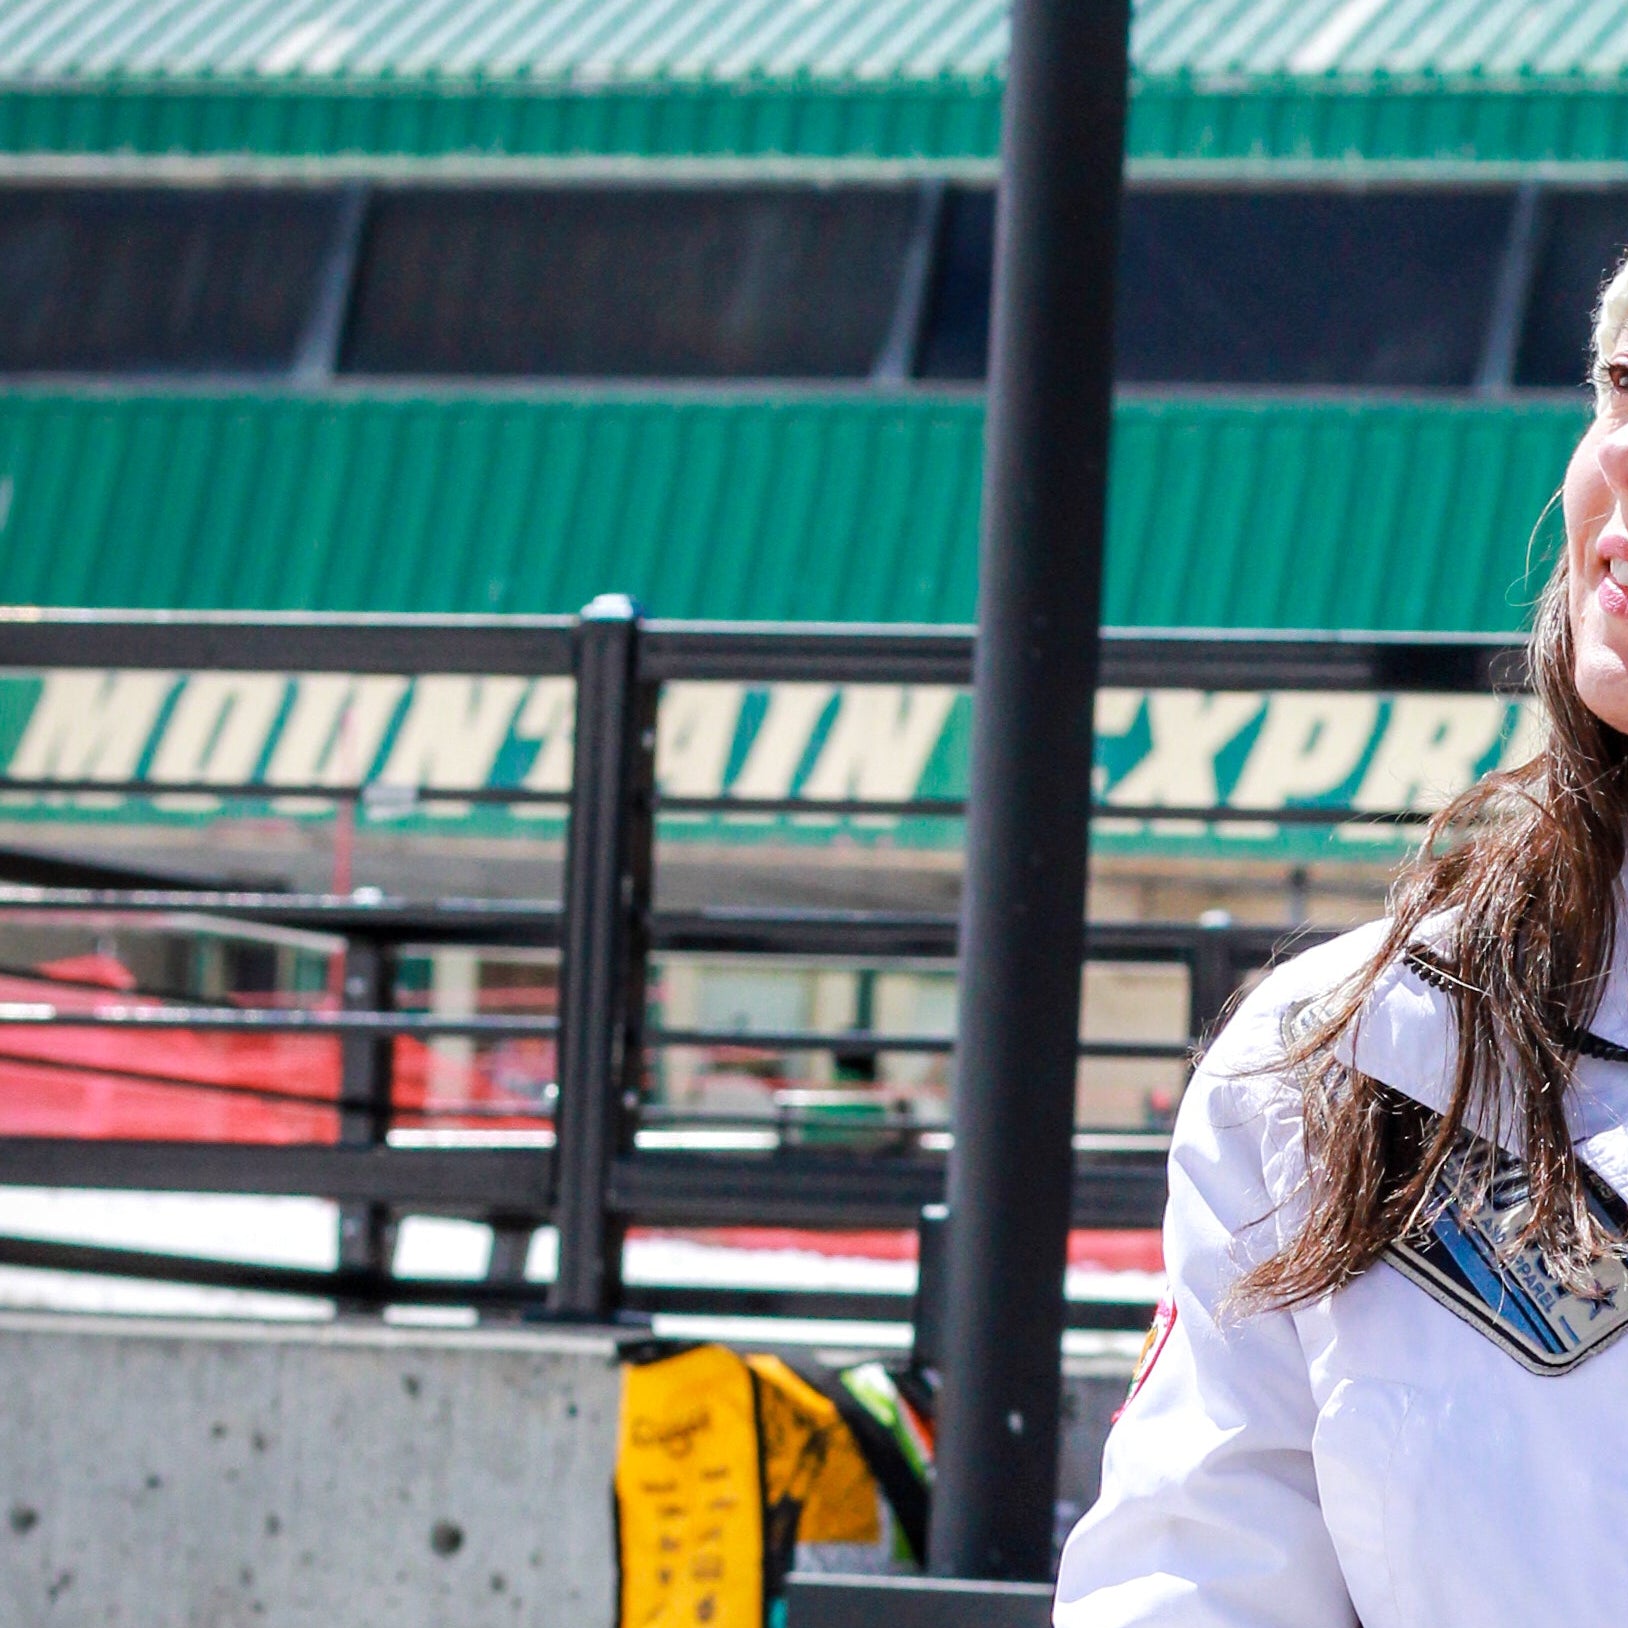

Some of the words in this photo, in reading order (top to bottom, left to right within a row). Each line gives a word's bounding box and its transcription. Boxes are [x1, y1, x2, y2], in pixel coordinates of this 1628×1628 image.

[0, 668, 958, 818] MOUNTAIN
[1093, 687, 1555, 840] XPR
[1511, 1255, 1555, 1314] PPAREL
